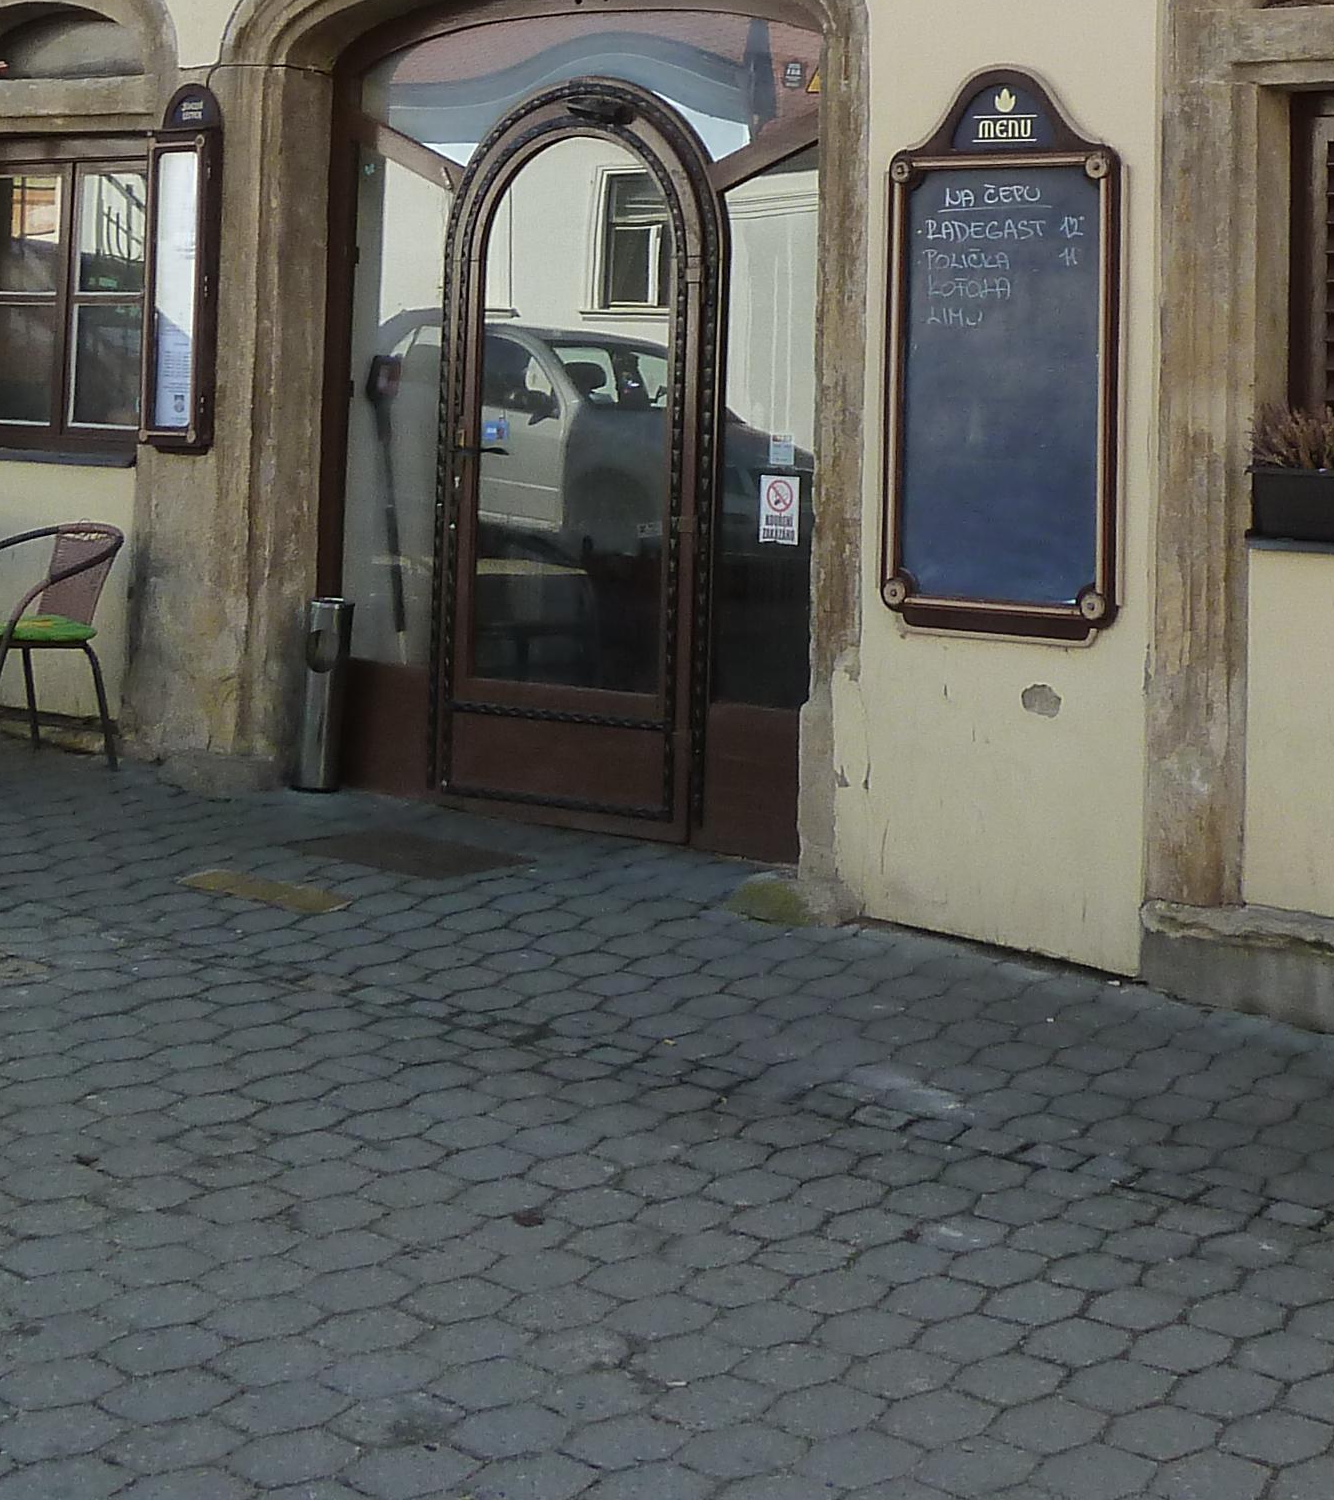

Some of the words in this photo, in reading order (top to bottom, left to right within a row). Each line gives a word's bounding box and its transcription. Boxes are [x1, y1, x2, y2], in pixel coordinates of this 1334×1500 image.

[978, 119, 1033, 139] MENU
[944, 187, 975, 207] NA
[983, 184, 1041, 204] ČEPU
[924, 218, 1046, 241] RADEGAST
[923, 247, 1011, 271] POLIČKA
